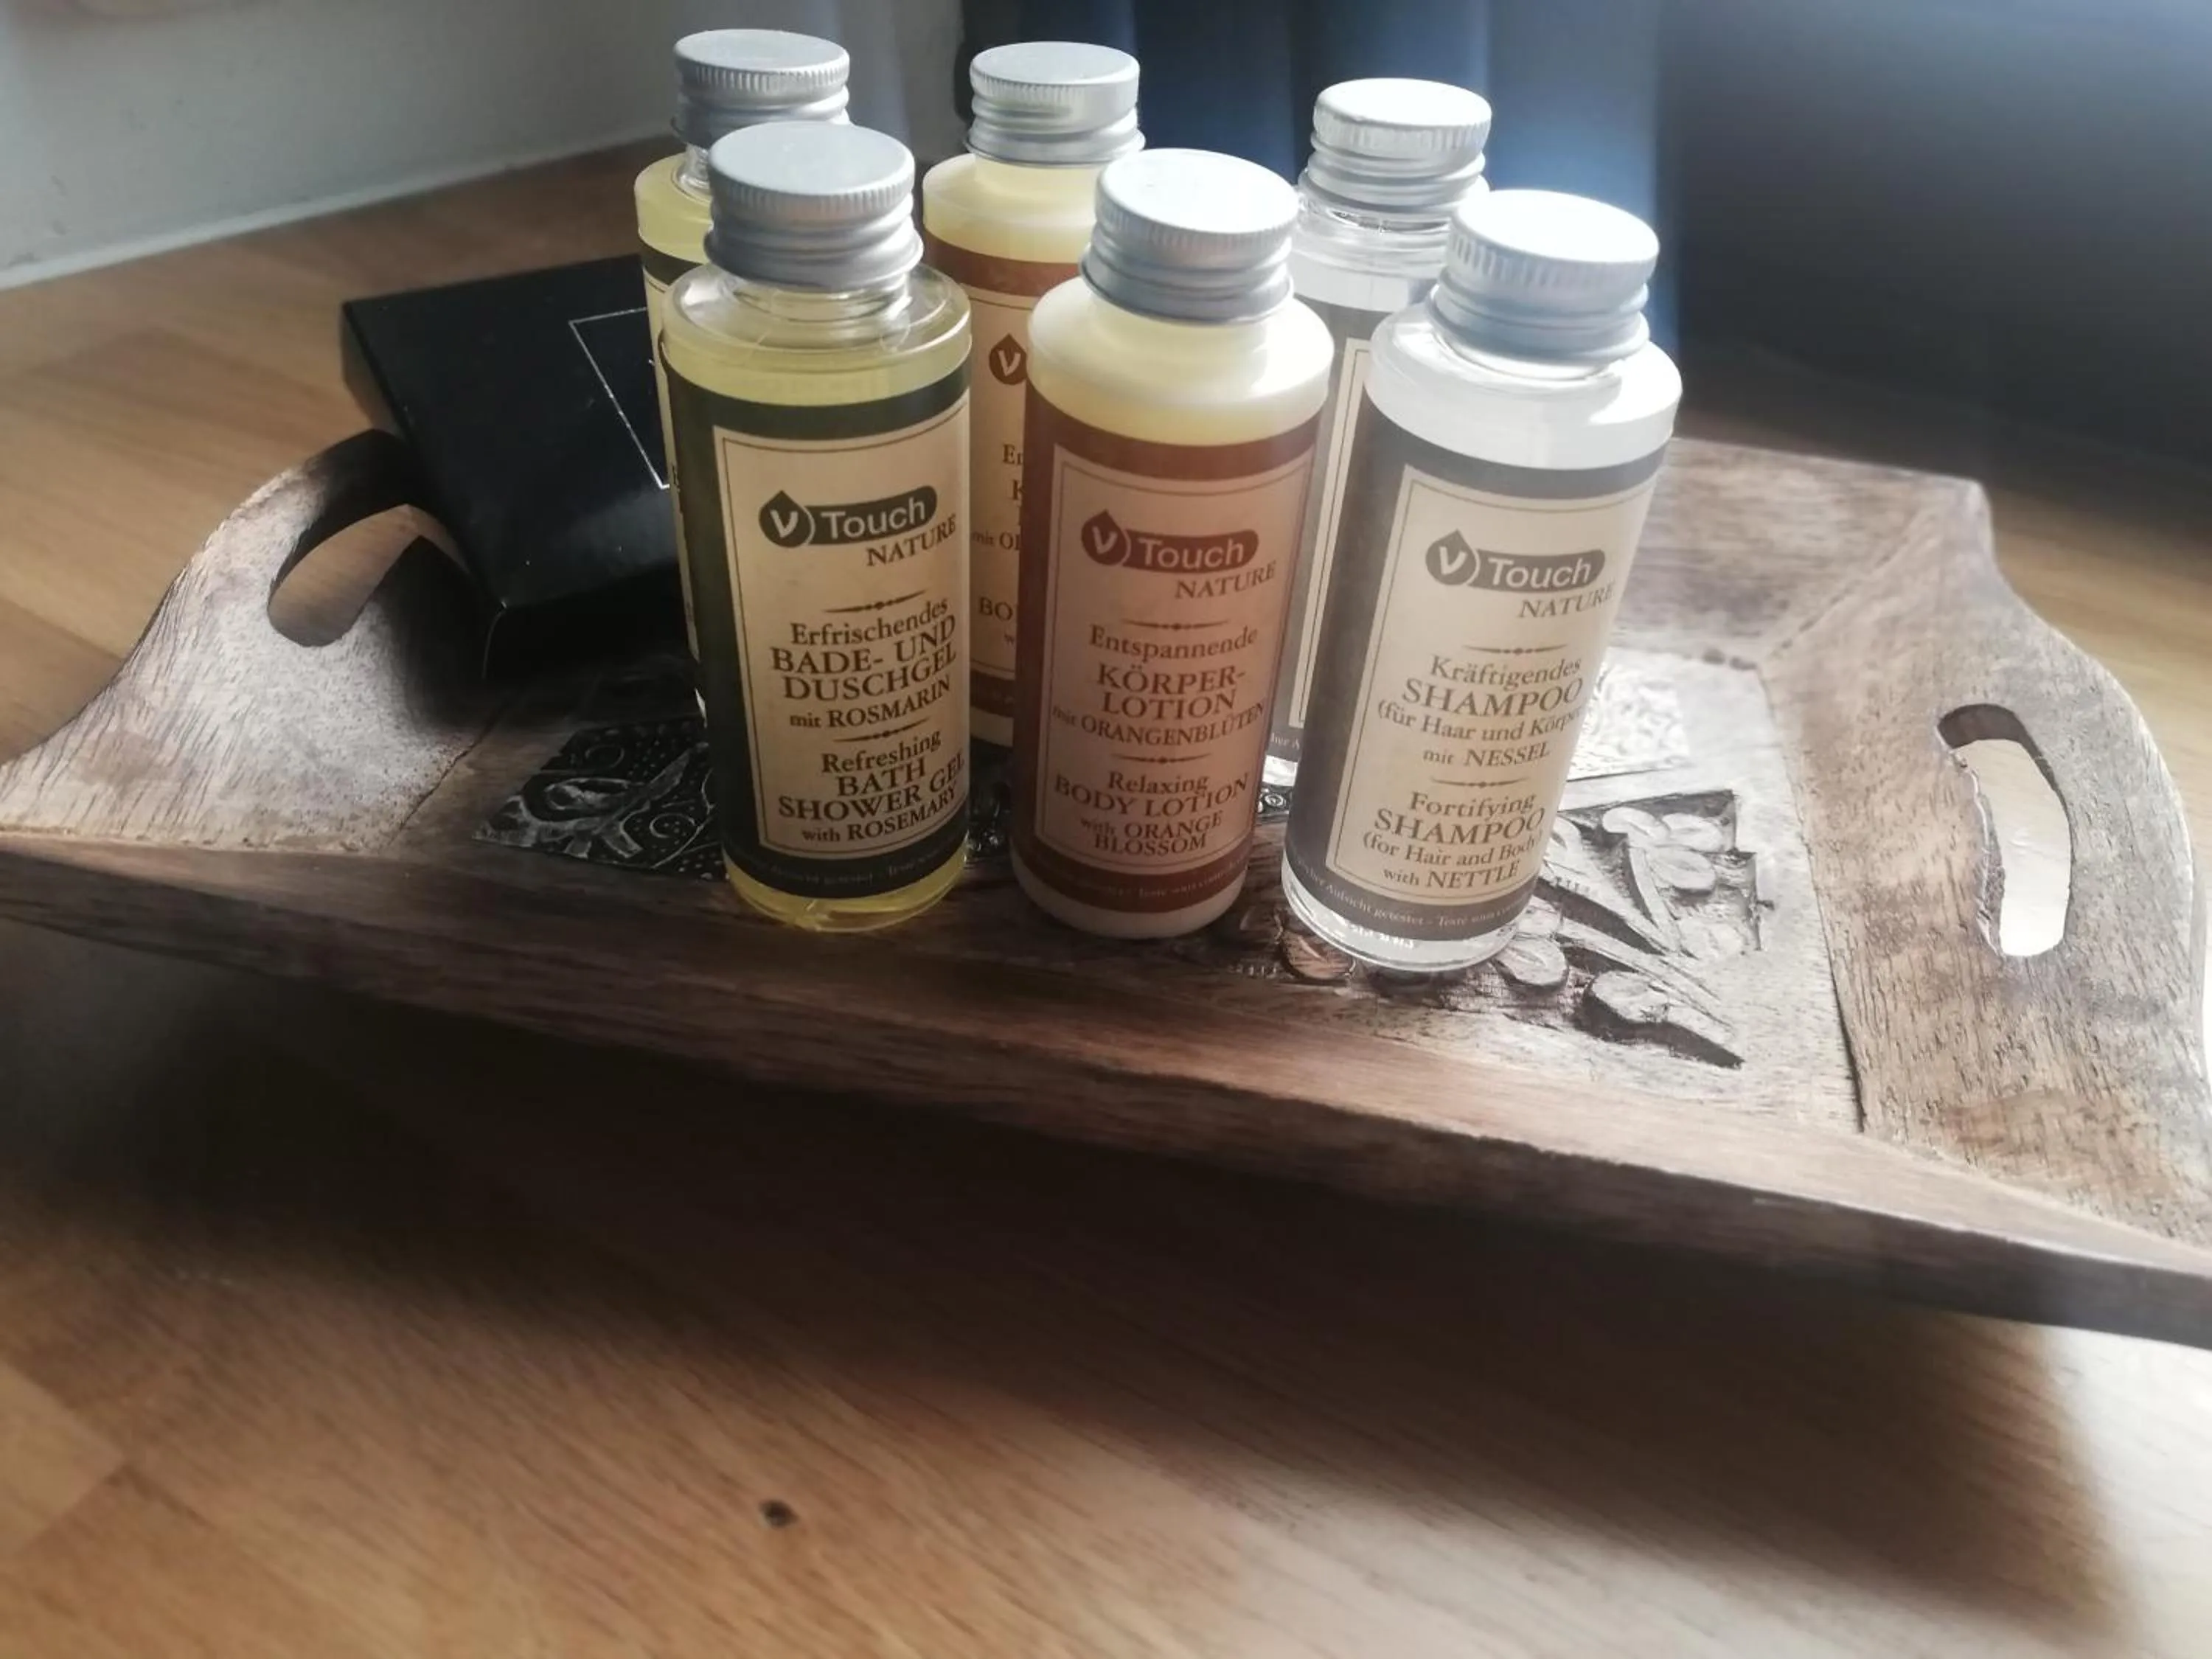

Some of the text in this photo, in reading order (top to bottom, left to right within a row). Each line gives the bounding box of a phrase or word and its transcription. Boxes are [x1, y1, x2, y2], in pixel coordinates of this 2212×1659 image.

[821, 497, 925, 539] Touch
[866, 515, 956, 567] NATURE
[1138, 537, 1243, 570] Touch
[1175, 560, 1276, 599] NATURE
[1488, 557, 1591, 588] Touch
[1518, 576, 1615, 618] NATURE
[790, 598, 948, 645] Erfrischendes
[770, 615, 956, 675] BADE- UND
[1088, 624, 1258, 663] Entspannende
[782, 642, 957, 700] DUSCHGEL
[1096, 663, 1246, 696] KÖRPER-
[1430, 655, 1582, 692] Kräftigendes
[790, 674, 950, 728] mit ROSMARIN
[1102, 689, 1237, 720] LOTION
[1402, 678, 1583, 718] SHAMPOO
[1377, 699, 1417, 728] (für
[1420, 714, 1477, 740] Haar
[1481, 720, 1525, 741] und
[821, 731, 942, 773] Refreshing
[1422, 742, 1551, 768] mit NESSEL
[778, 751, 965, 821] SHOWER GEL
[835, 757, 927, 797] BATH
[1054, 773, 1249, 817] BODY LOTION
[1108, 771, 1209, 796] Relaxing
[801, 782, 958, 843] with ROSEMARY
[1080, 810, 1223, 840] with ORANGE
[1374, 807, 1545, 845] SHAMPOO
[1411, 791, 1536, 822] Fortifying
[1094, 833, 1207, 858] BLOSSOM
[1363, 832, 1399, 857] (for
[1405, 845, 1452, 866] Hair
[1455, 847, 1495, 866] and
[1383, 858, 1520, 891] with NETTLE
